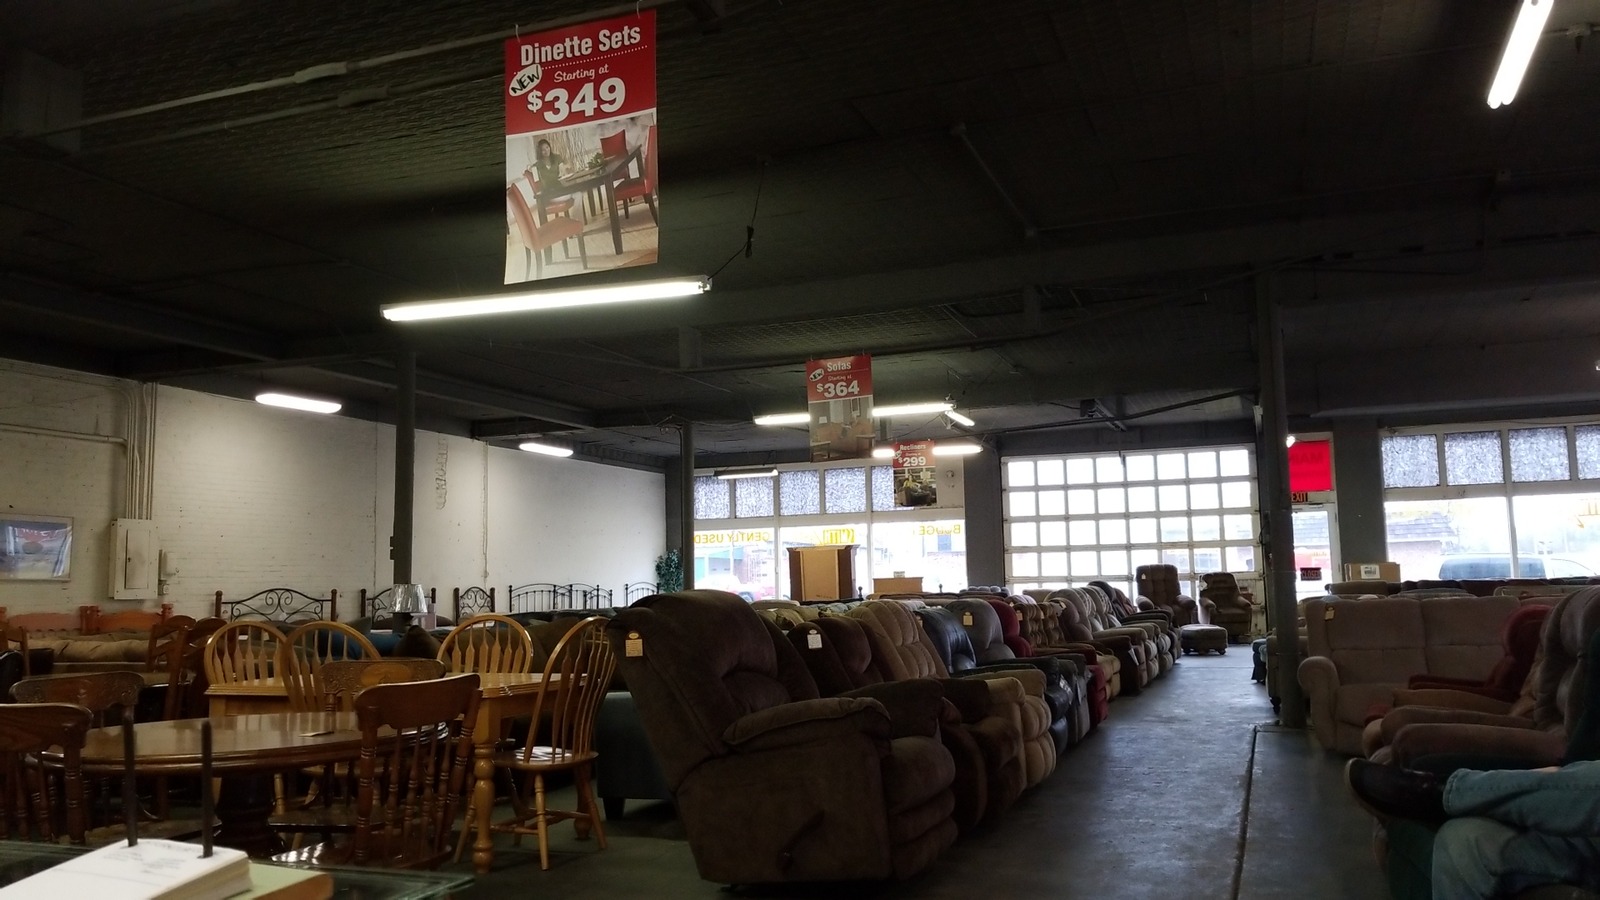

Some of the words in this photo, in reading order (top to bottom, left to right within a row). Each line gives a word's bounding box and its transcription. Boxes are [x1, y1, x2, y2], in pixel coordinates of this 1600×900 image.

[520, 36, 592, 66] Dinette
[598, 25, 641, 52] Sets
[511, 65, 541, 94] NEW
[553, 67, 596, 83] Starting
[598, 63, 610, 75] at
[527, 77, 626, 123] $349
[826, 361, 852, 372] Sofas
[816, 380, 860, 398] $364
[898, 456, 927, 466] $299
